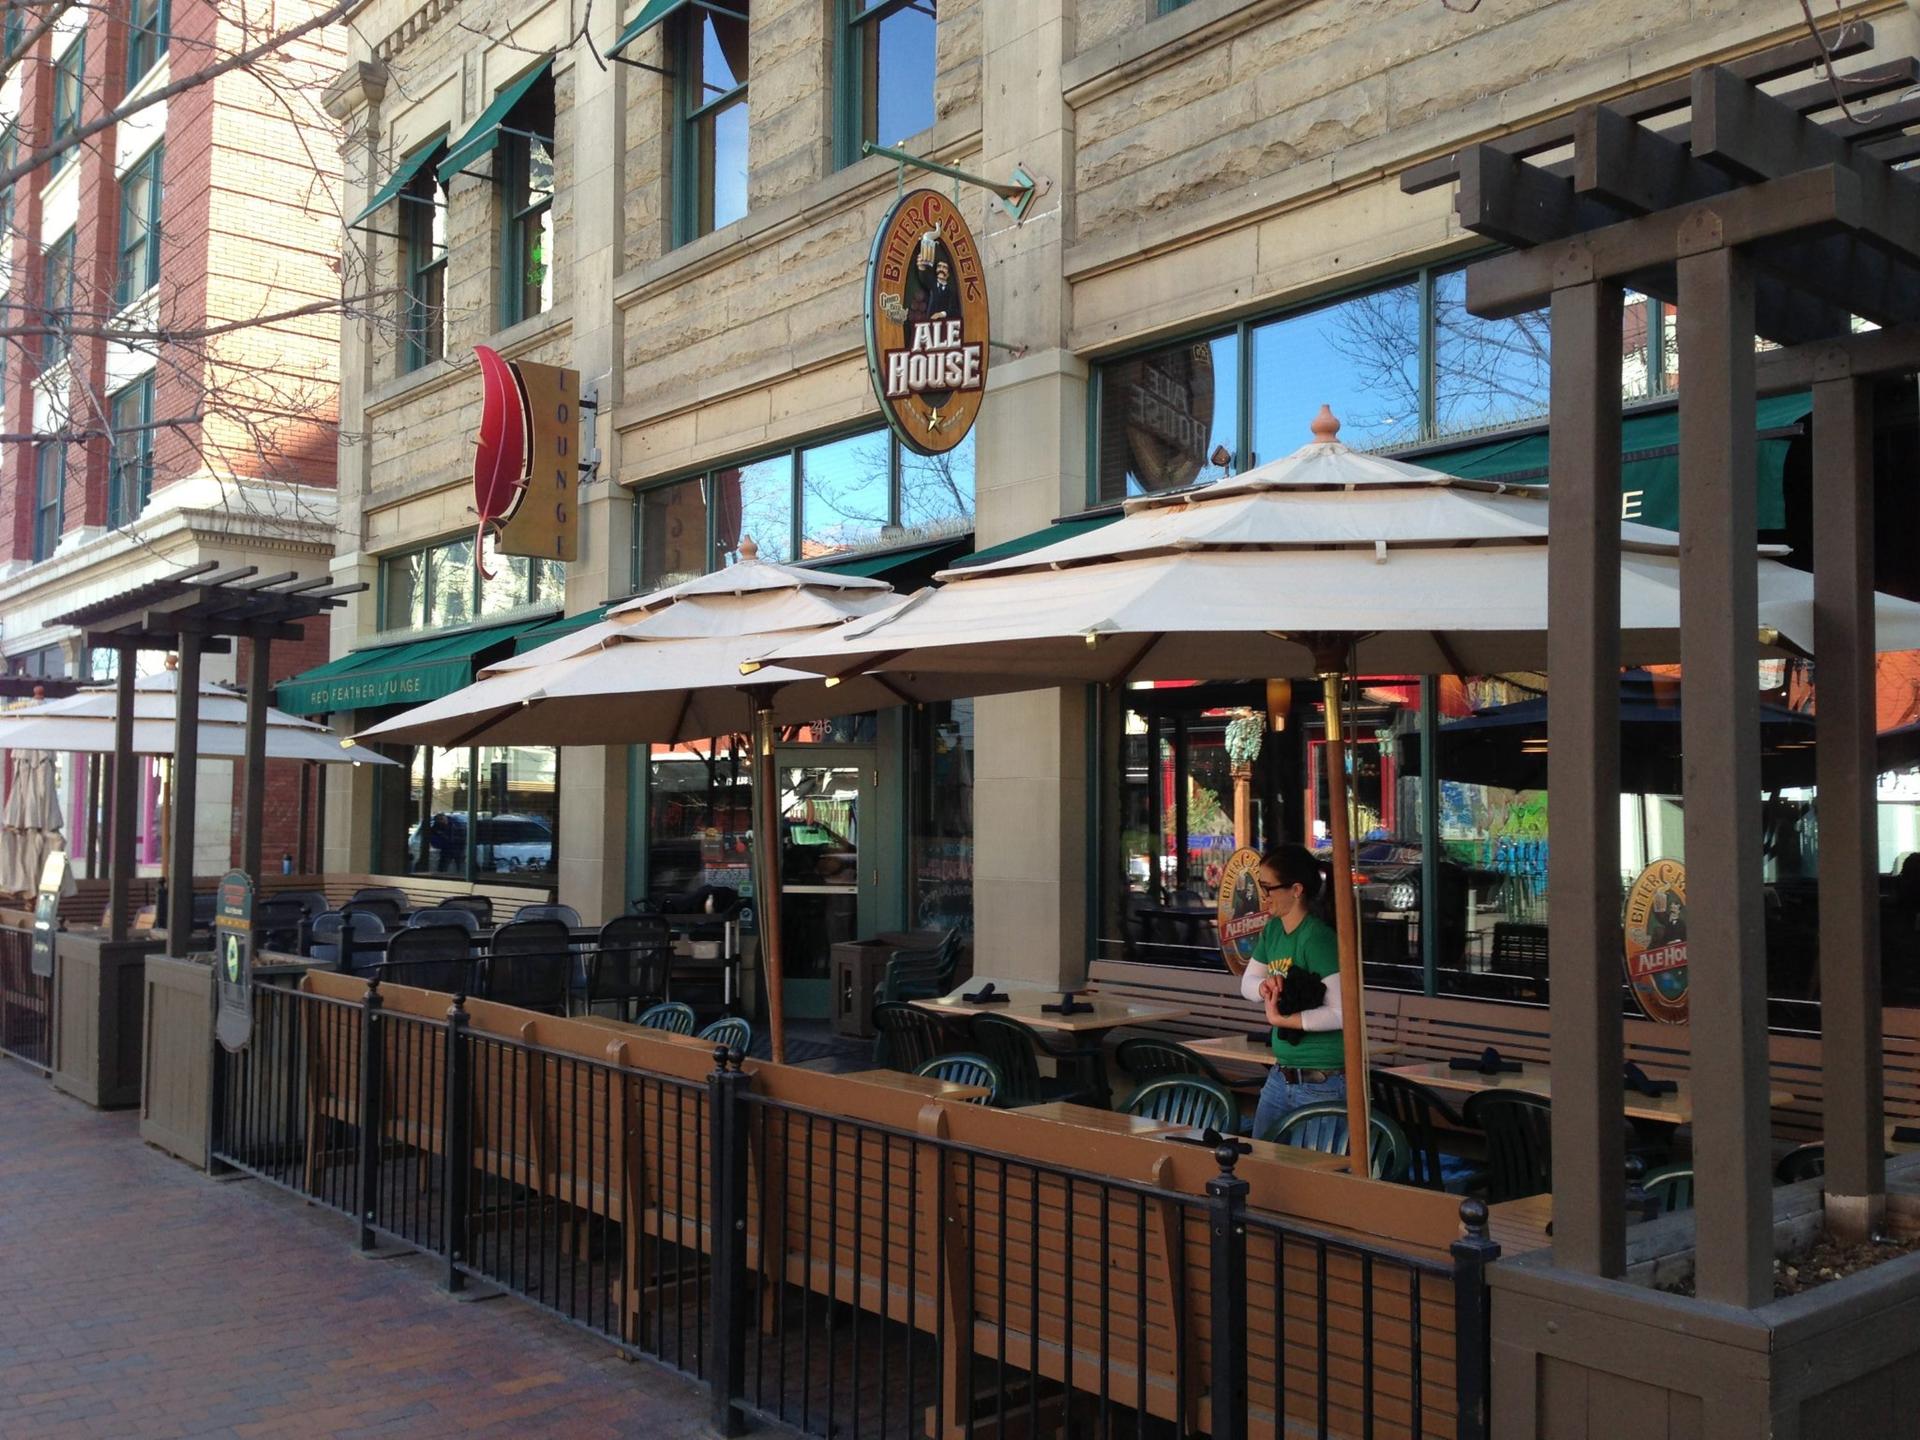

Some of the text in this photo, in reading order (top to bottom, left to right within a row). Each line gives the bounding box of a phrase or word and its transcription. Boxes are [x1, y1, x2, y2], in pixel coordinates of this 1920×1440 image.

[884, 194, 982, 304] BITTER CREEK
[912, 320, 962, 352] ALE
[887, 346, 982, 398] HOUSE
[332, 684, 375, 701] FEATHER
[1631, 874, 1660, 923] BITTER
